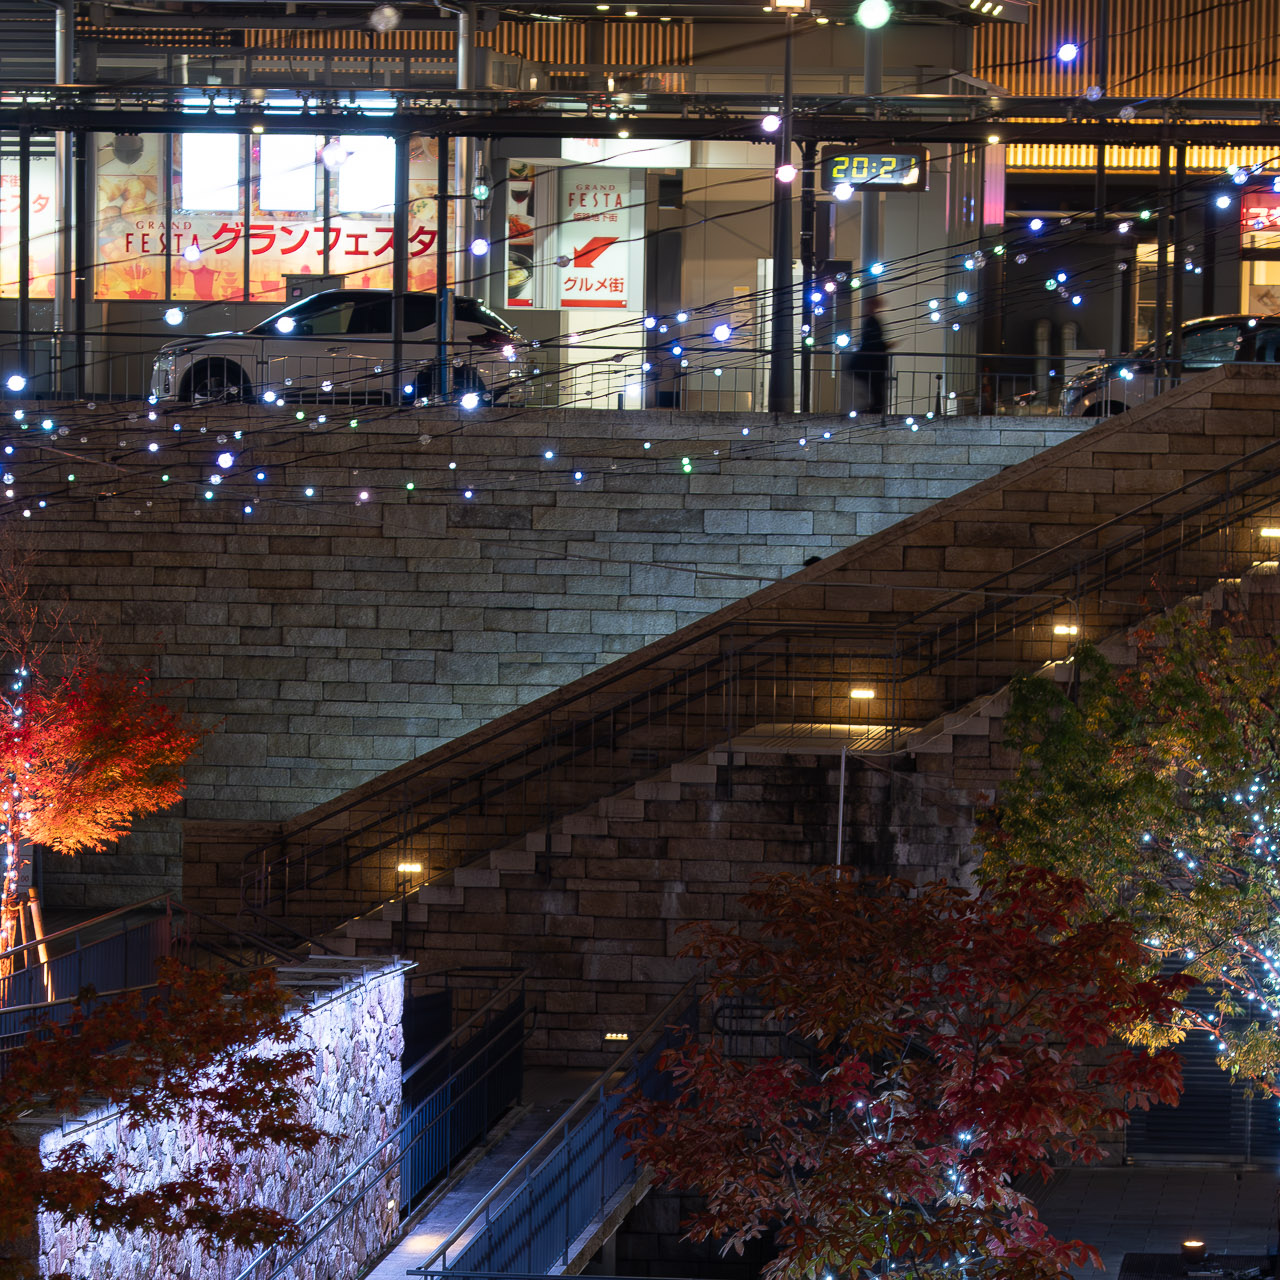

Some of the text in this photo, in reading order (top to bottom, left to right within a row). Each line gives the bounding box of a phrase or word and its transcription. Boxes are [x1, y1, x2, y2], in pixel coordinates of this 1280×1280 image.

[831, 156, 916, 179] 20:21
[575, 183, 616, 191] GRAND
[567, 192, 624, 208] FESTA
[135, 220, 193, 231] GRAND
[125, 231, 201, 254] FESTA
[211, 221, 439, 258] グランフェスタ
[563, 276, 625, 293] グルメ街
